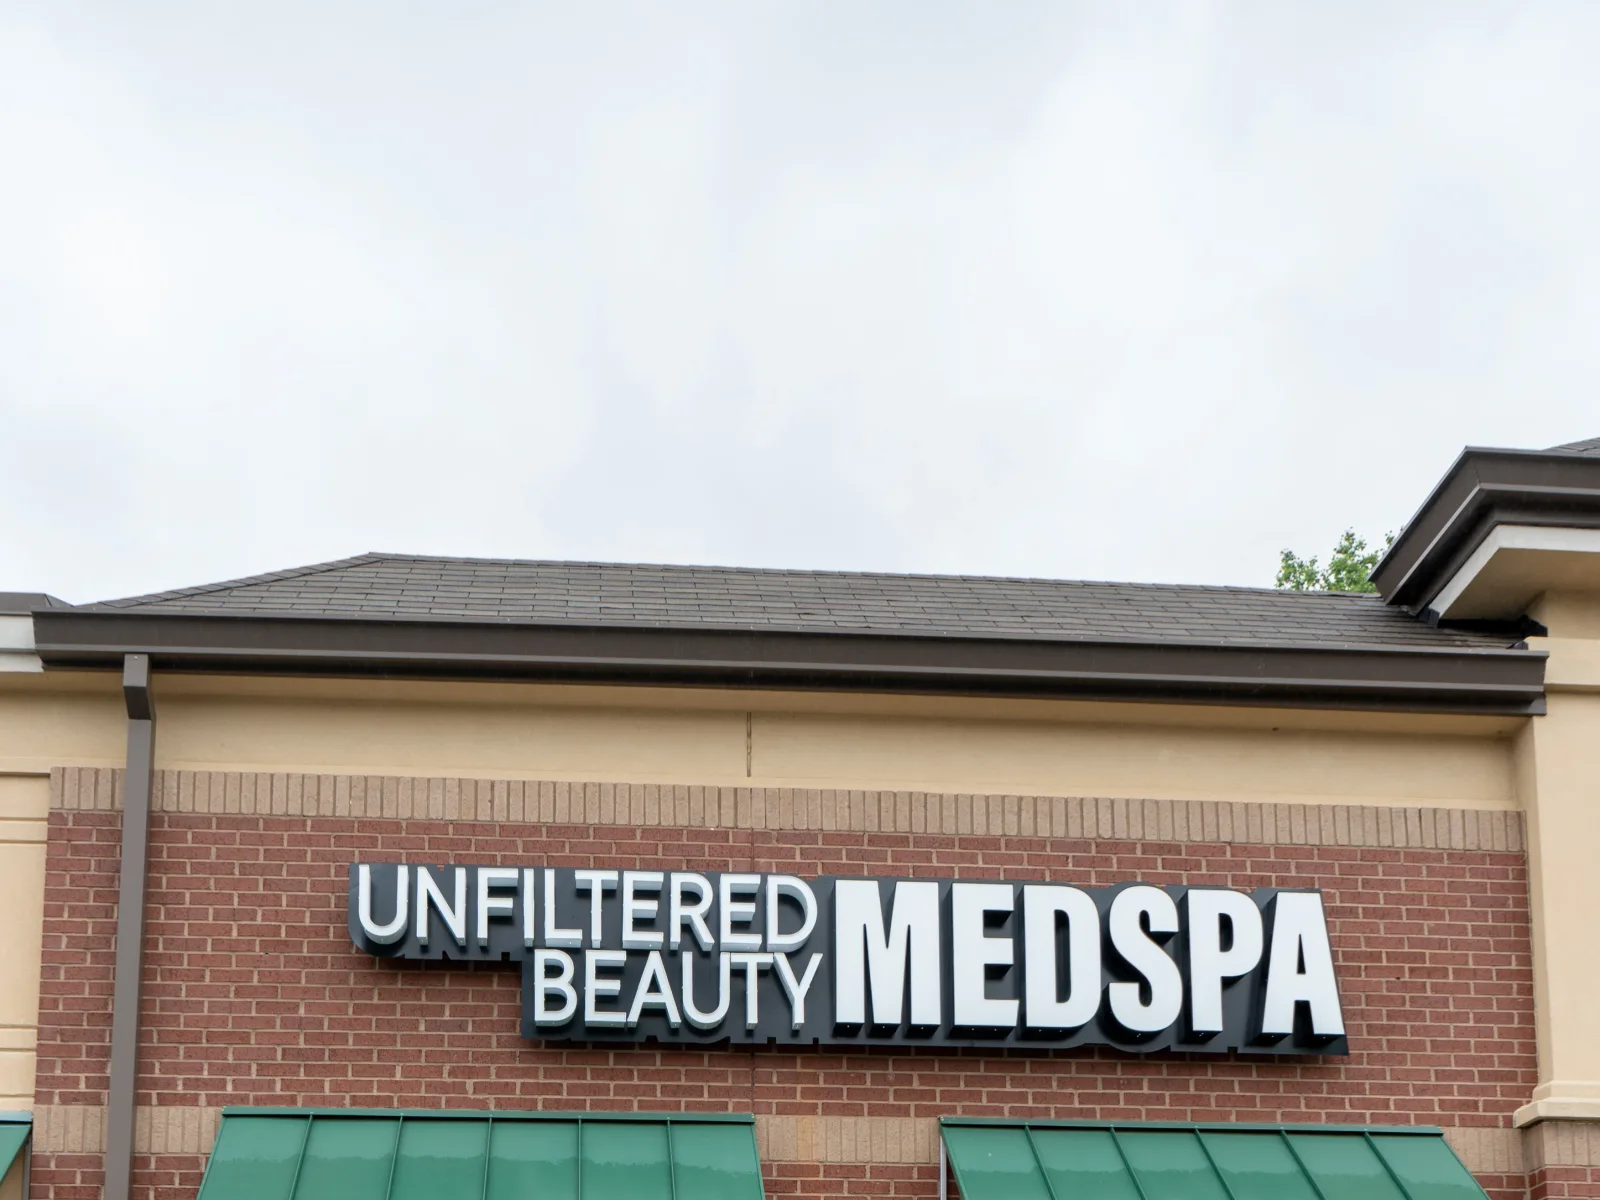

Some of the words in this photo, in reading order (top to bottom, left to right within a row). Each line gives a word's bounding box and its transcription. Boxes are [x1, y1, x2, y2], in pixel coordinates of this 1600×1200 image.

[358, 864, 819, 953] UNFILTERED
[533, 948, 824, 1030] BEAUTY
[834, 878, 1346, 1039] MEDSPA
